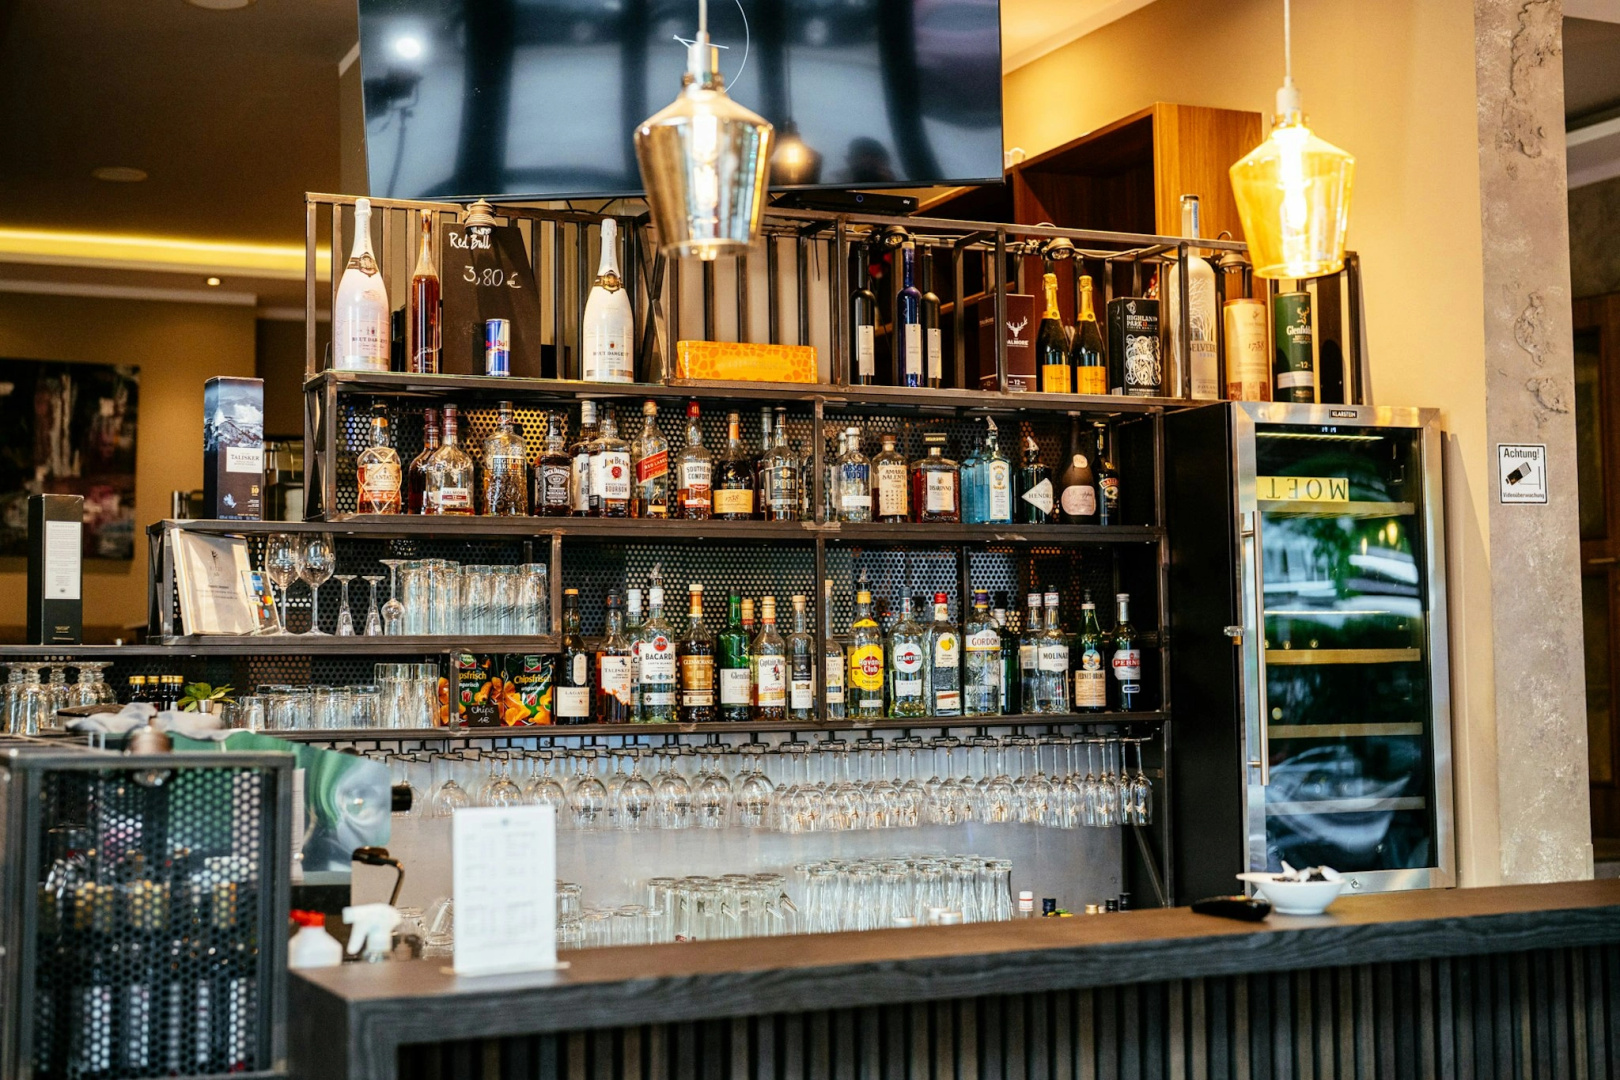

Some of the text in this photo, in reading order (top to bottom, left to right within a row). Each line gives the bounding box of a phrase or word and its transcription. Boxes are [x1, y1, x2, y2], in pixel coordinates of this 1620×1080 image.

[448, 232, 491, 250] Red Bull
[463, 265, 522, 289] 3,80 €
[1504, 448, 1540, 461] Achtung!
[972, 637, 1000, 646] GORDON
[863, 665, 878, 673] Club
[459, 671, 487, 682] psfrisch
[514, 674, 552, 684] Chipsfrisch
[471, 706, 495, 717] Chips
